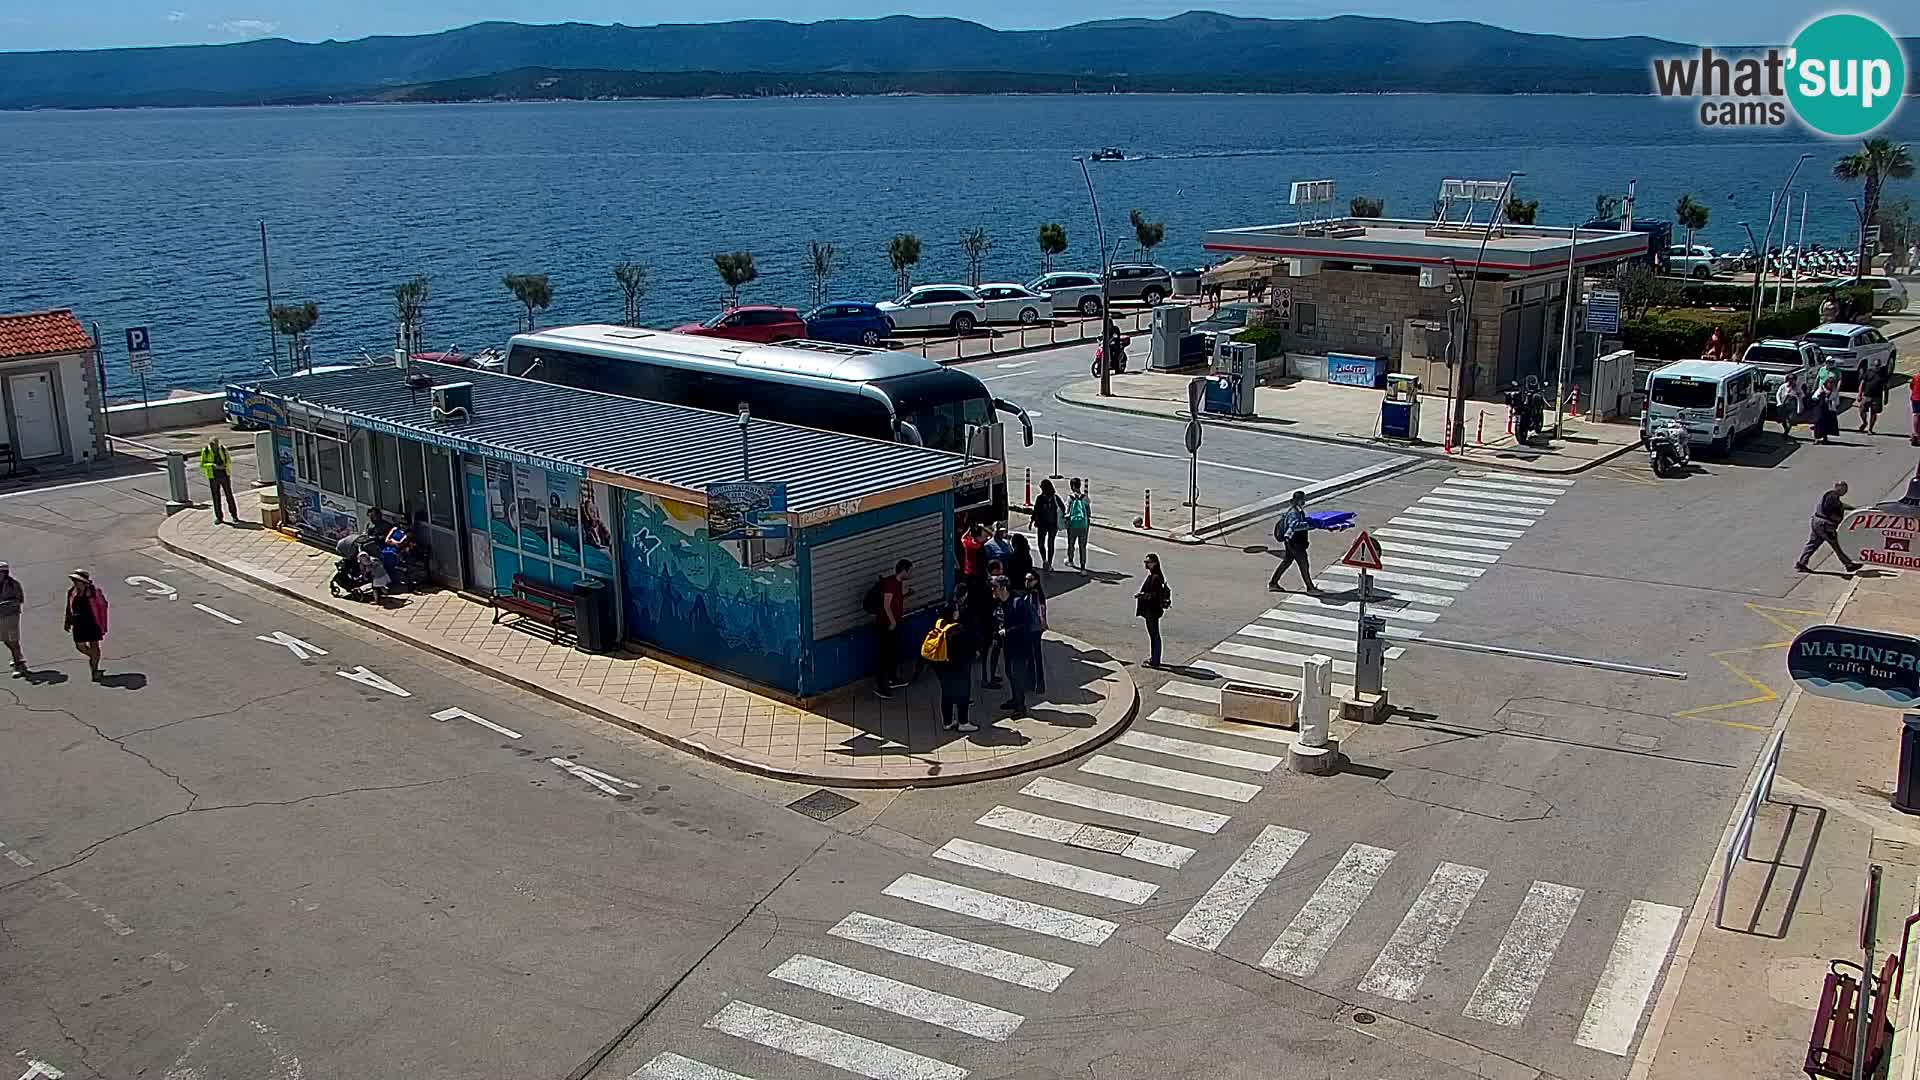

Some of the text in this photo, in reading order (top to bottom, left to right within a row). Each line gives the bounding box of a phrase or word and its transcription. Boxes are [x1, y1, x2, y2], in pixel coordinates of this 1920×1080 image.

[131, 330, 144, 349] P
[437, 436, 469, 451] POSTAJA
[479, 446, 494, 457] BUS
[494, 448, 527, 464] STATION
[529, 456, 555, 471] TICKET
[556, 462, 583, 476] OFFICE
[1849, 514, 1920, 532] PIZZE
[1870, 664, 1896, 679] bar
